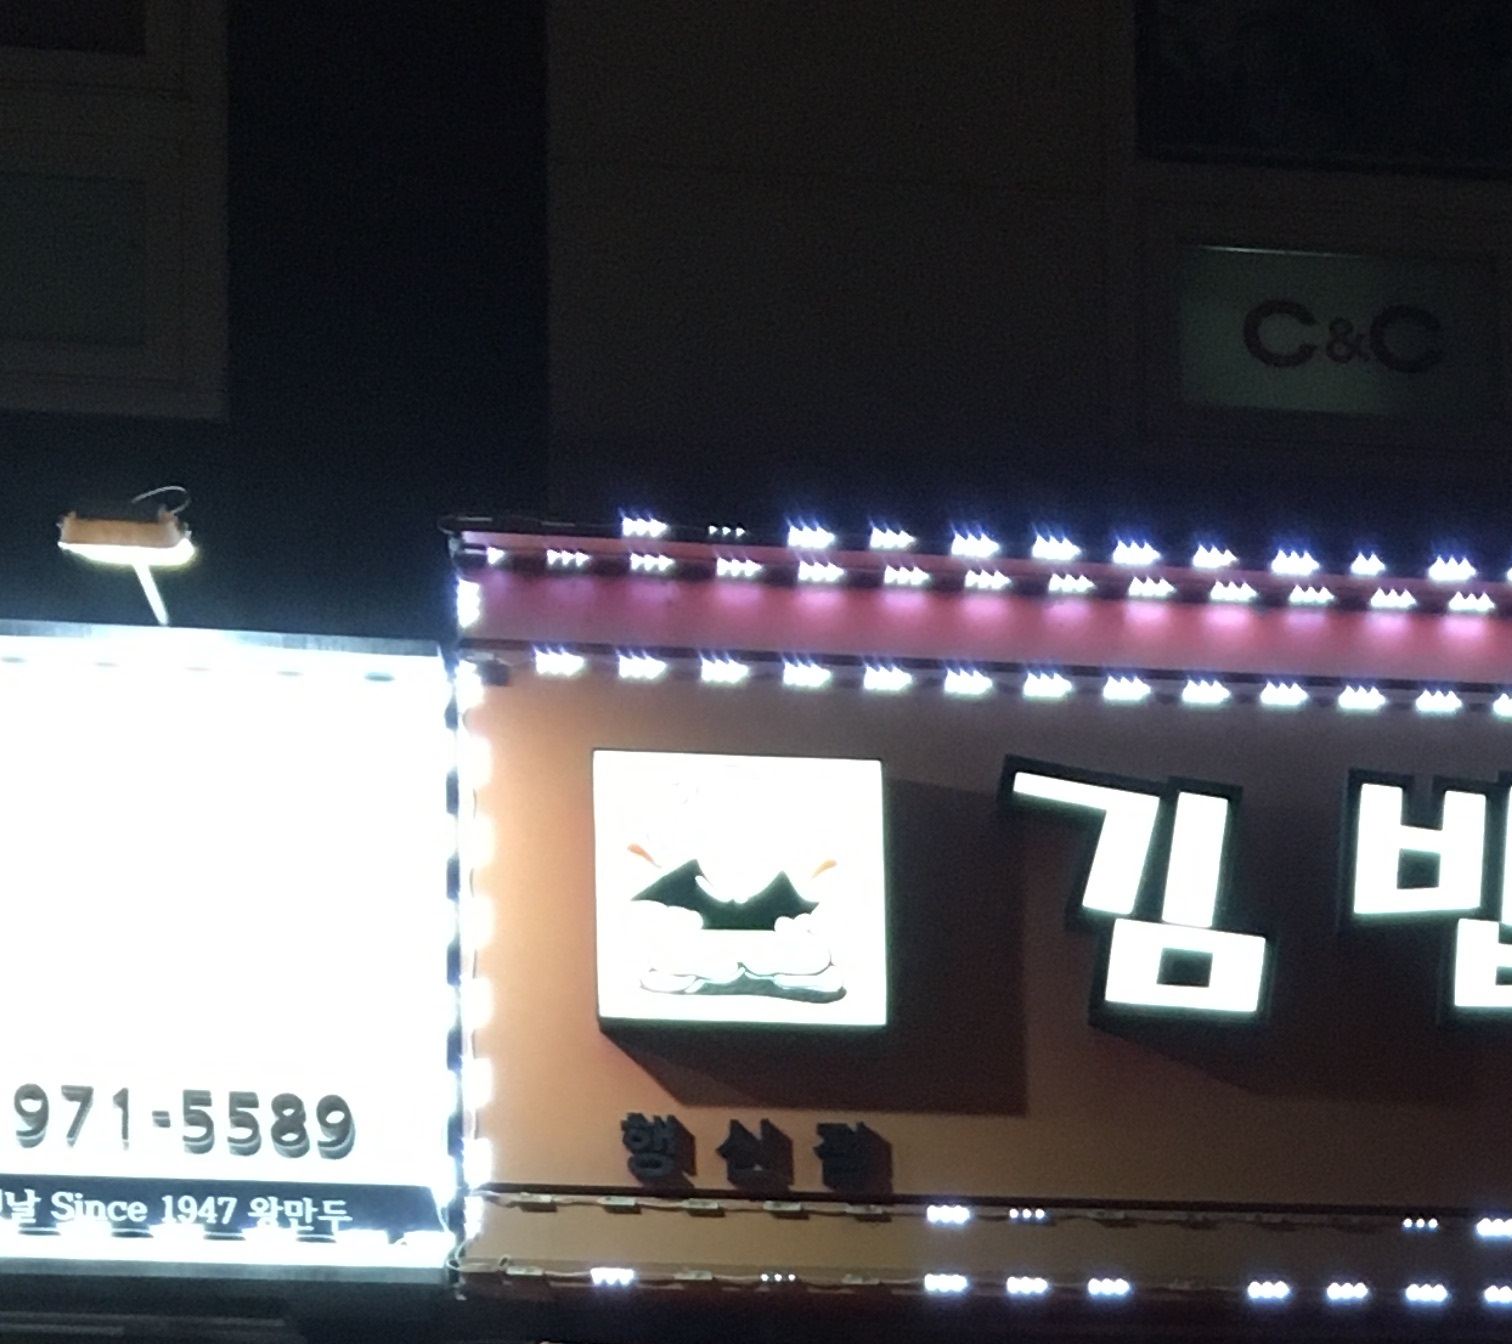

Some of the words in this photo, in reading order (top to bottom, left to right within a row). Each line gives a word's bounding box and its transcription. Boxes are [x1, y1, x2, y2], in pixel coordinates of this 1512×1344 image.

[1244, 300, 1445, 373] C&C
[13, 1083, 356, 1160] 971-5589
[0, 1188, 41, 1225] 날
[50, 1191, 148, 1222] Since
[161, 1194, 237, 1225] 1947
[248, 1197, 353, 1231] 왕만두
